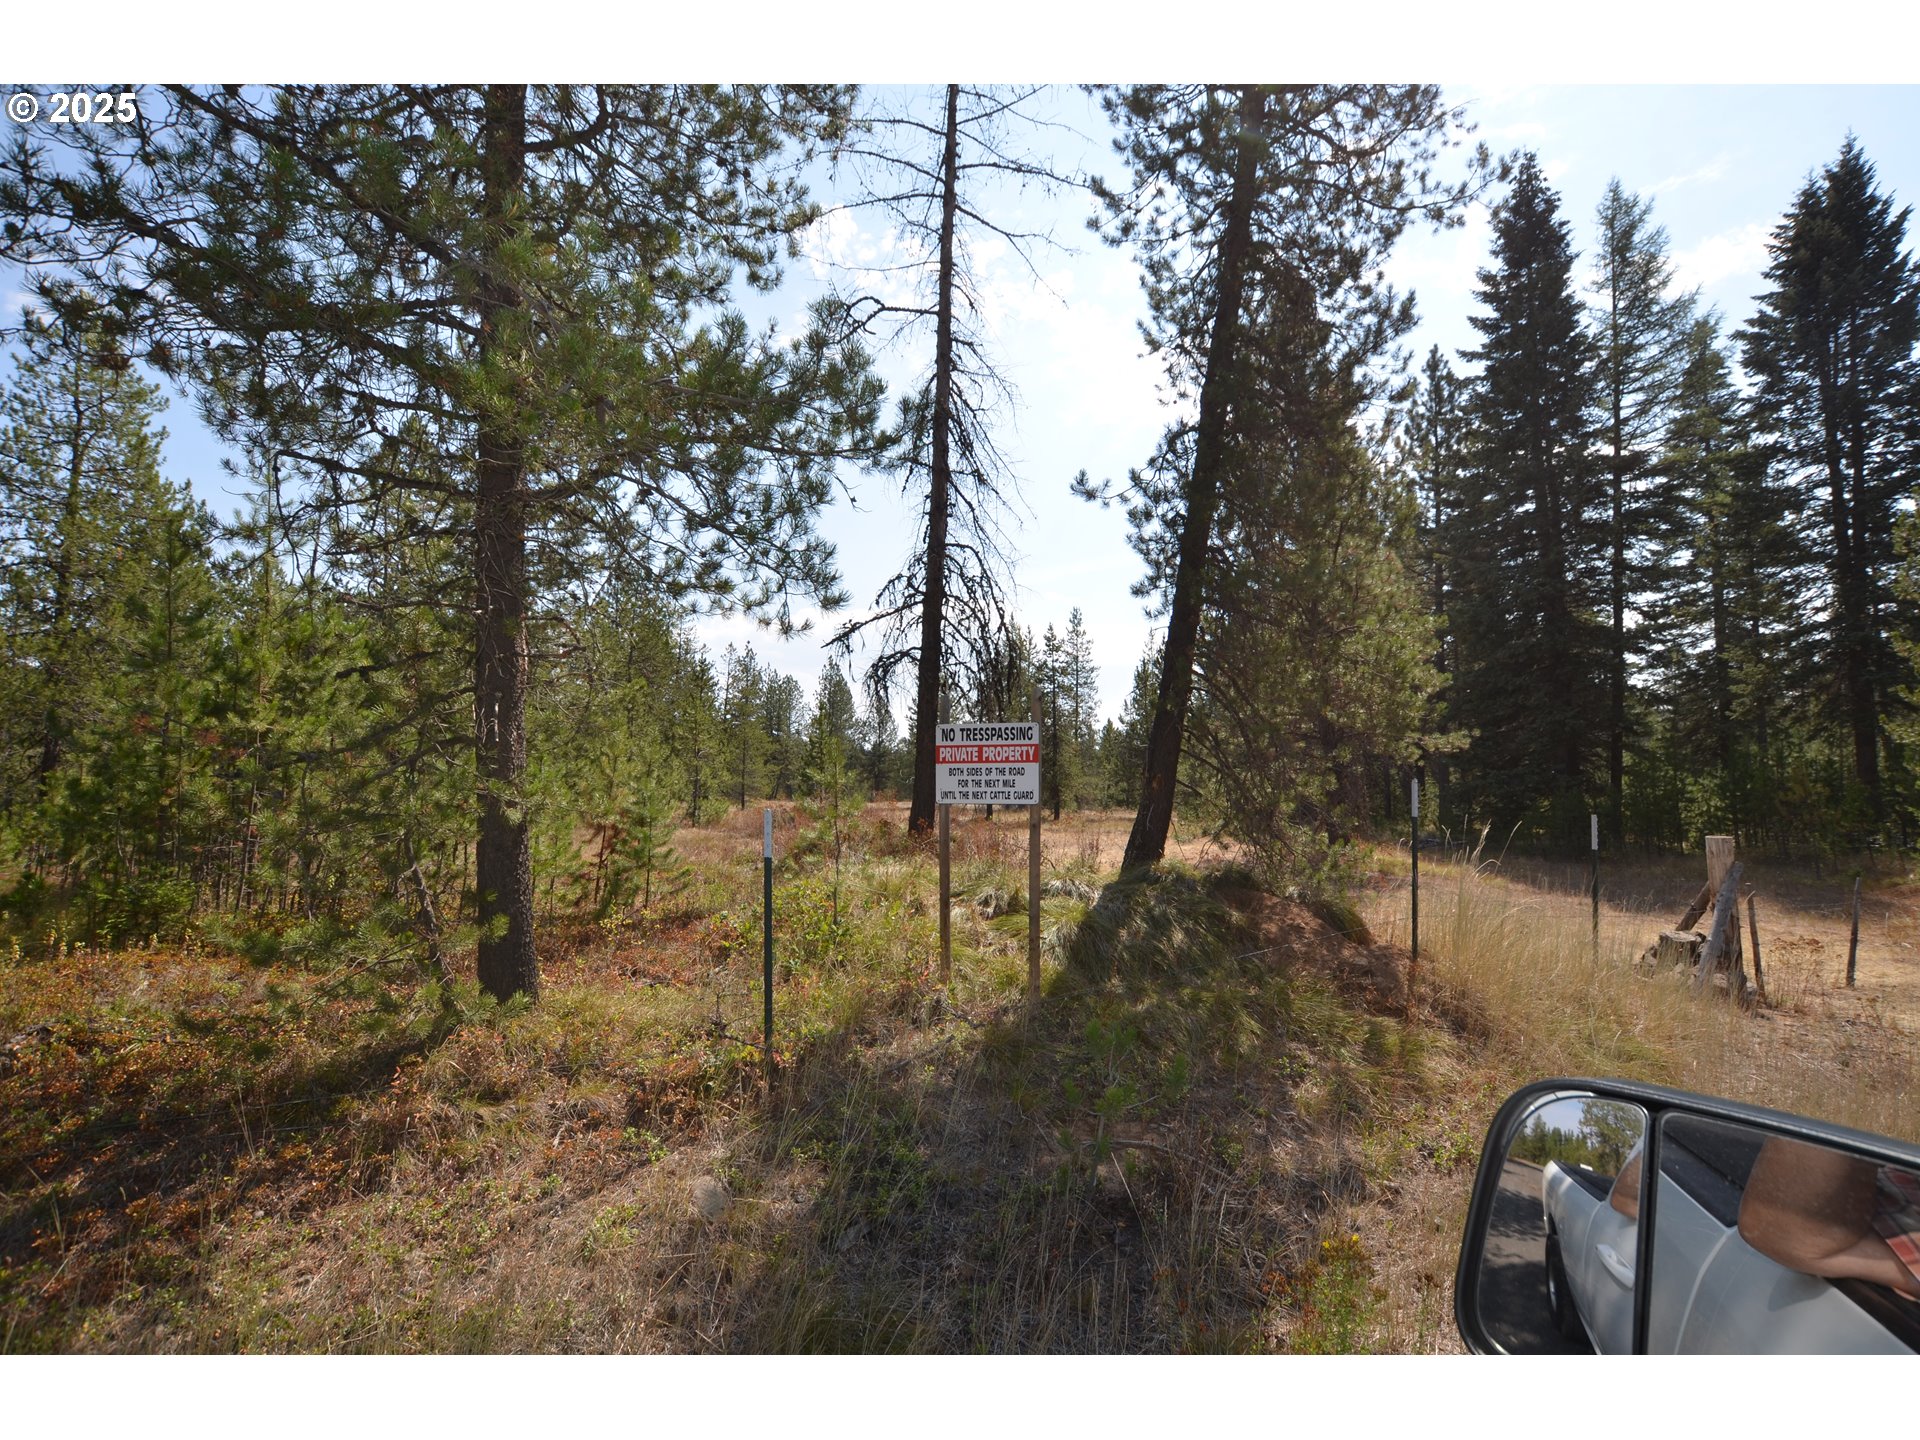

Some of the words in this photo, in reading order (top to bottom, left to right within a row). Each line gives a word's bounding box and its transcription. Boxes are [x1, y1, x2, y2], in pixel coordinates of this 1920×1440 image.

[942, 728, 955, 742] NO
[960, 727, 1033, 741] TRESSPASSING
[940, 747, 978, 761] PRIVATE
[983, 746, 1035, 761] PROPERTY
[949, 768, 964, 776] BOTH
[966, 768, 982, 776] SIDES
[985, 768, 992, 776] OF
[995, 768, 1006, 776] THE
[1009, 767, 1025, 776] ROAD
[958, 779, 968, 788] FOR
[972, 779, 982, 787] THE
[985, 779, 999, 787] NEXT
[1002, 779, 1015, 787] MILE
[941, 791, 956, 799] UNTIL
[959, 791, 969, 799] THE
[972, 791, 987, 799] NEXT
[990, 791, 1010, 799] CATTLE
[1014, 791, 1034, 799] GUARD
